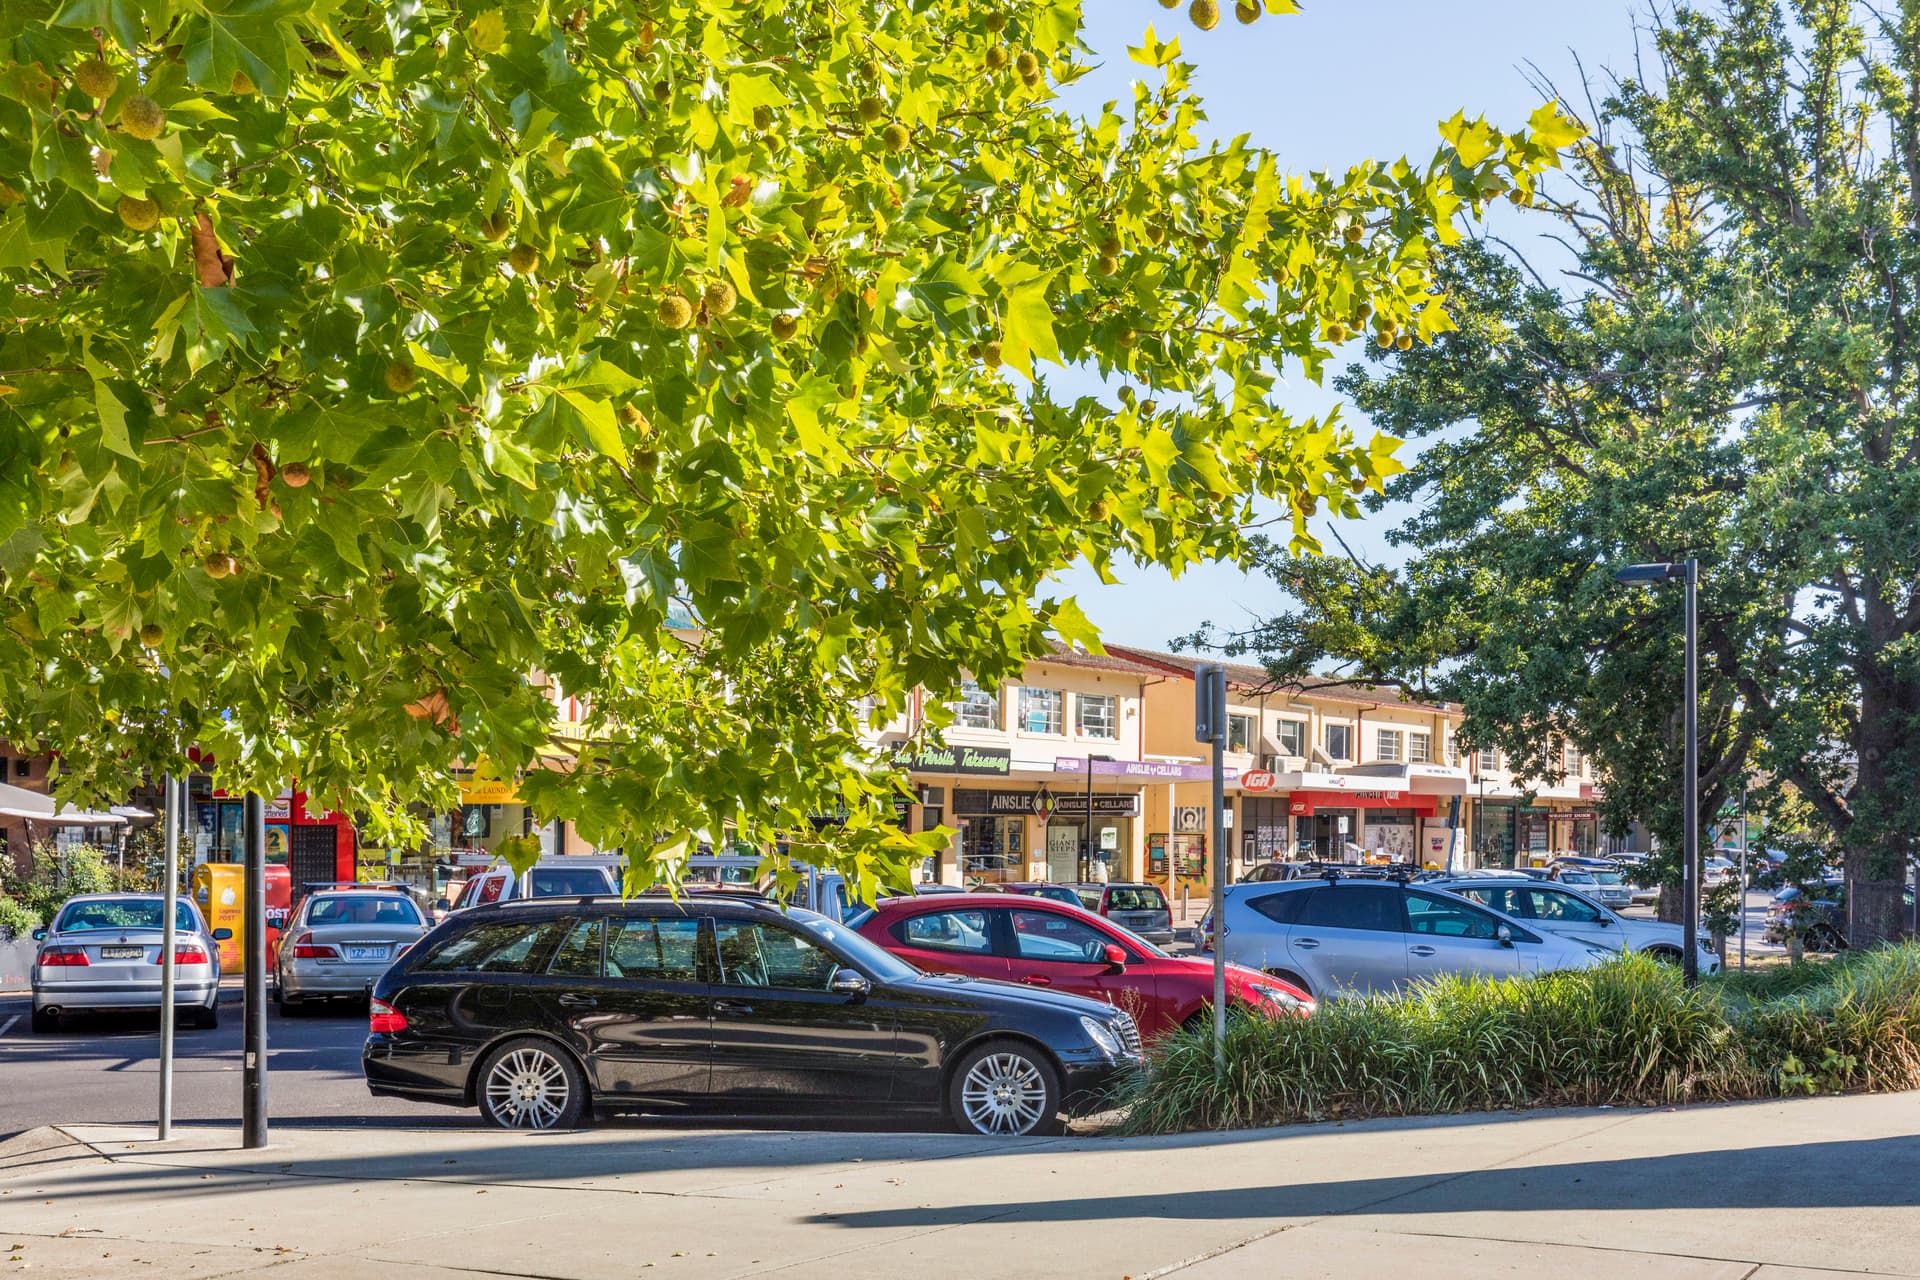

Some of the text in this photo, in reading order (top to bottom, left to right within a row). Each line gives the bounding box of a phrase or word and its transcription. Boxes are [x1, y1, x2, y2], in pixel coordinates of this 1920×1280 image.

[962, 748, 1009, 771] Takeaway
[1126, 763, 1182, 777] AINSLIE CELLARS
[1245, 773, 1271, 787] IGA
[991, 795, 1031, 810] AINSLIE
[1058, 800, 1088, 809] AINSLIE
[265, 908, 289, 919] OST
